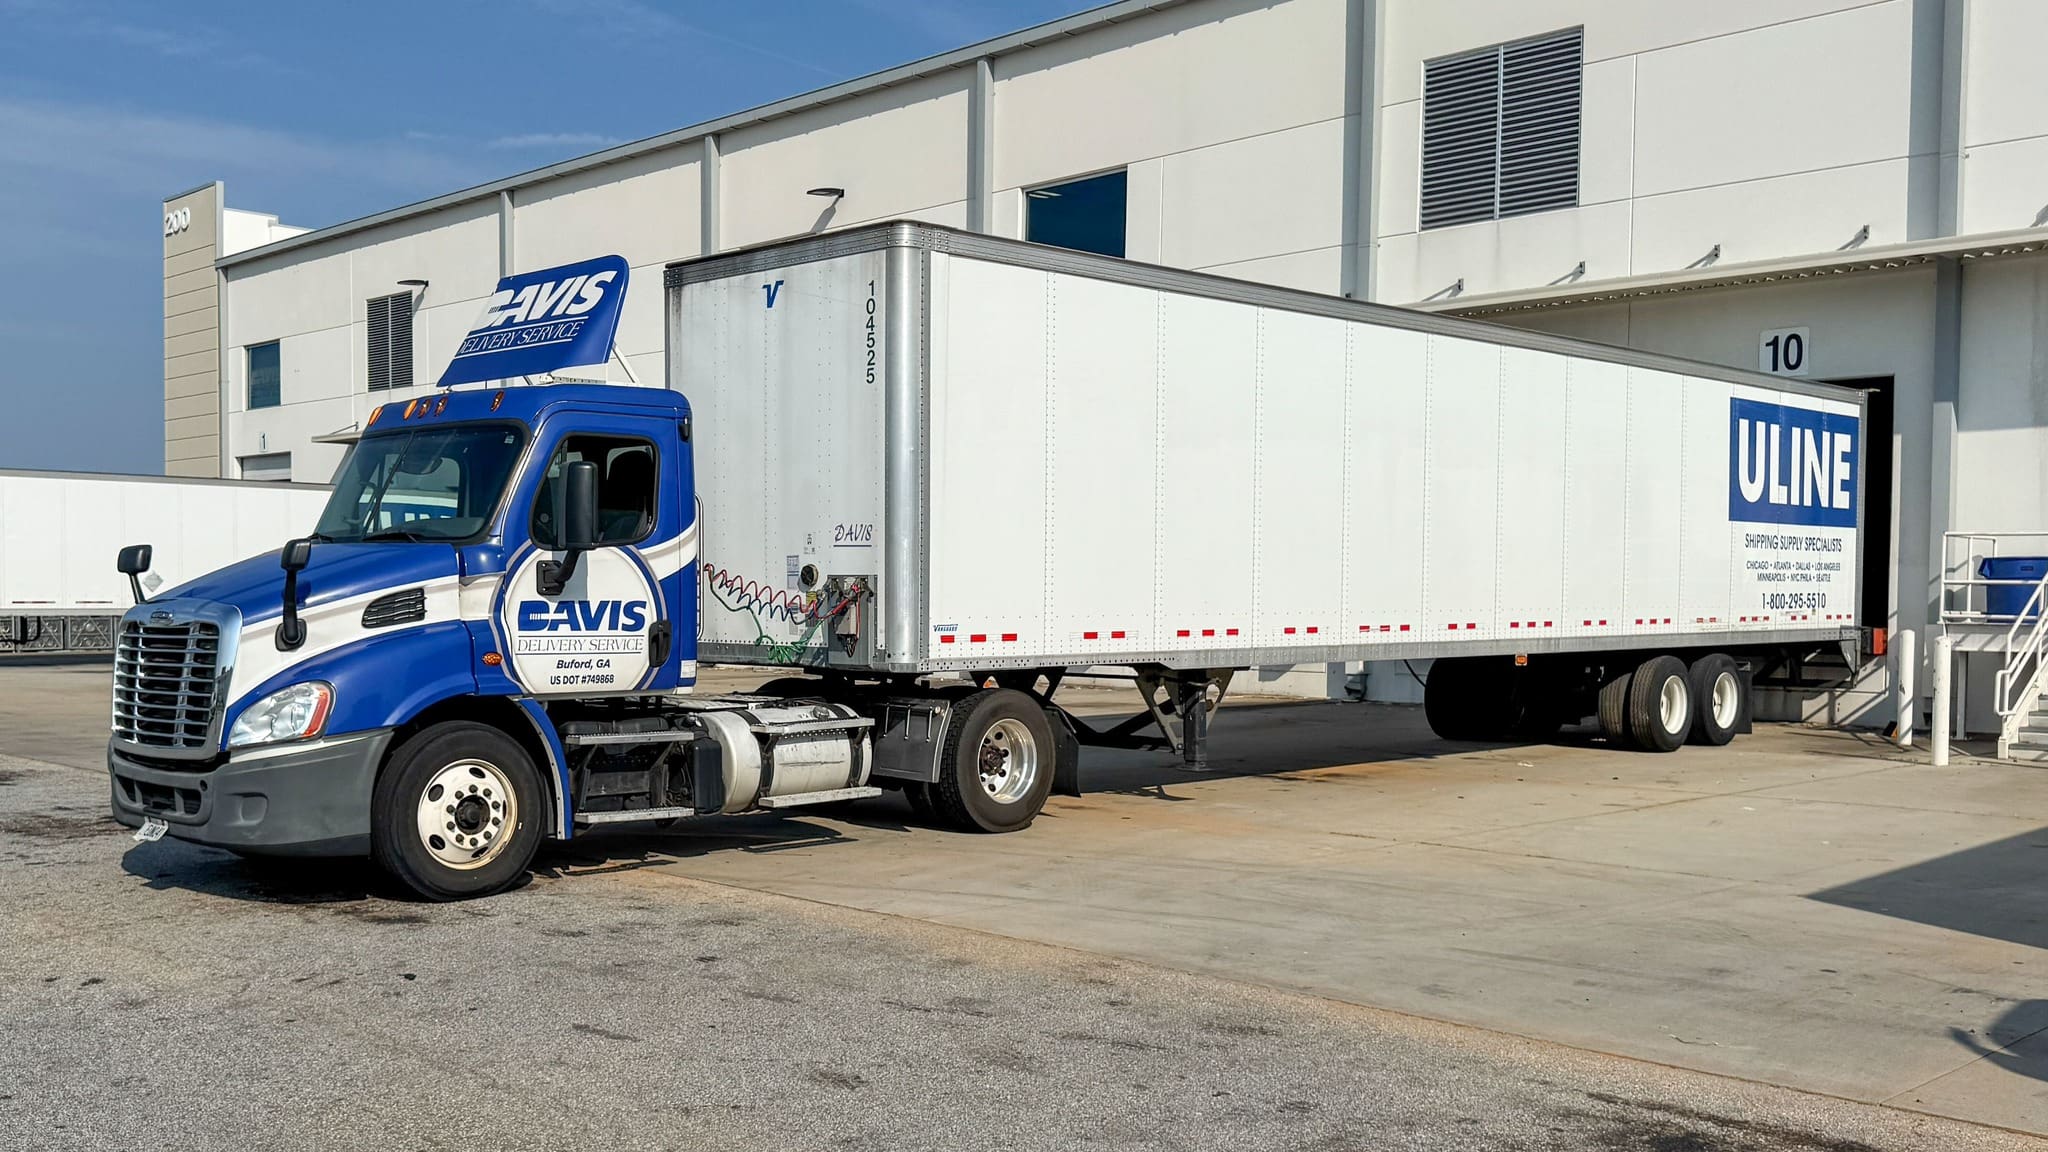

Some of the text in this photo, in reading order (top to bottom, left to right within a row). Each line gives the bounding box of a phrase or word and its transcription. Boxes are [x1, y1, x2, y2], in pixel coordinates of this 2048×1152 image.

[164, 207, 190, 236] 200
[470, 271, 617, 332] DAVIS
[517, 321, 584, 345] SERVICE
[865, 280, 876, 384] 104525
[1765, 333, 1803, 372] 10
[1738, 418, 1851, 510] ULINE
[834, 523, 873, 542] DAVIS
[1745, 533, 1842, 552] SHIPPING SUPPLY SPECIALISTS
[1746, 560, 1769, 570] CHICAGO
[1773, 561, 1791, 570] ATLANTA
[1795, 561, 1811, 571] DALLAS
[1814, 562, 1823, 571] LOS
[1757, 573, 1786, 582] MINNEAPOLIS
[1815, 573, 1831, 582] SEATTLE
[1762, 592, 1827, 609] 1-800-295-5510
[518, 600, 648, 632] DAVIS
[517, 638, 643, 652] DELIVERY SERVICE
[556, 659, 611, 670] Buford, GA
[550, 674, 615, 685] US DOT #749868
